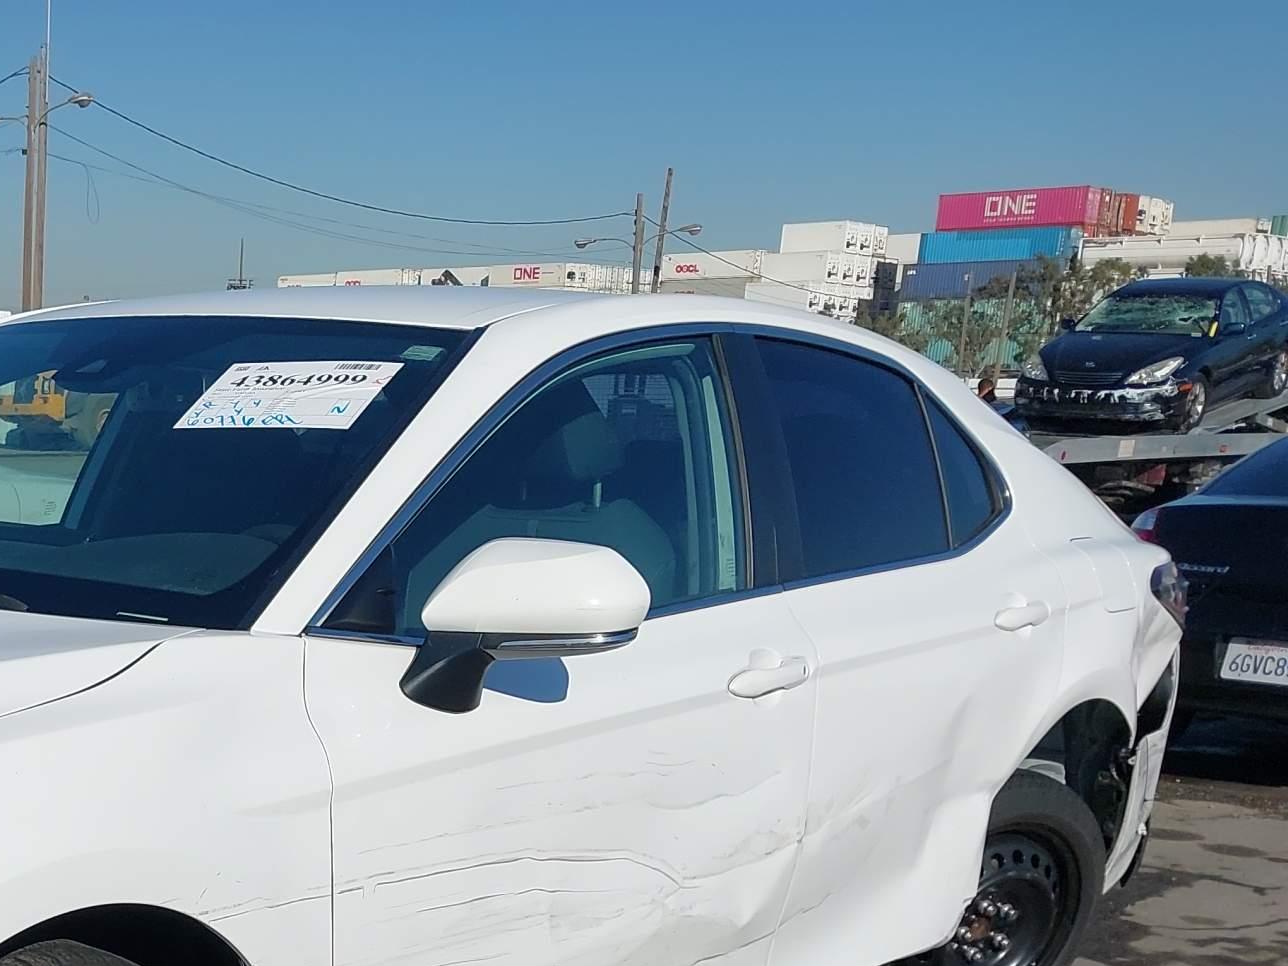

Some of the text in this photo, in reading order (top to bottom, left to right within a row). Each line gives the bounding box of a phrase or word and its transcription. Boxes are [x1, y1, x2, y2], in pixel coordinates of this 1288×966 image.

[983, 193, 1038, 217] ONE
[513, 266, 541, 280] ONE
[675, 264, 699, 273] OOCL
[230, 373, 368, 388] 43864999
[1229, 653, 1288, 677] 6GVC8
